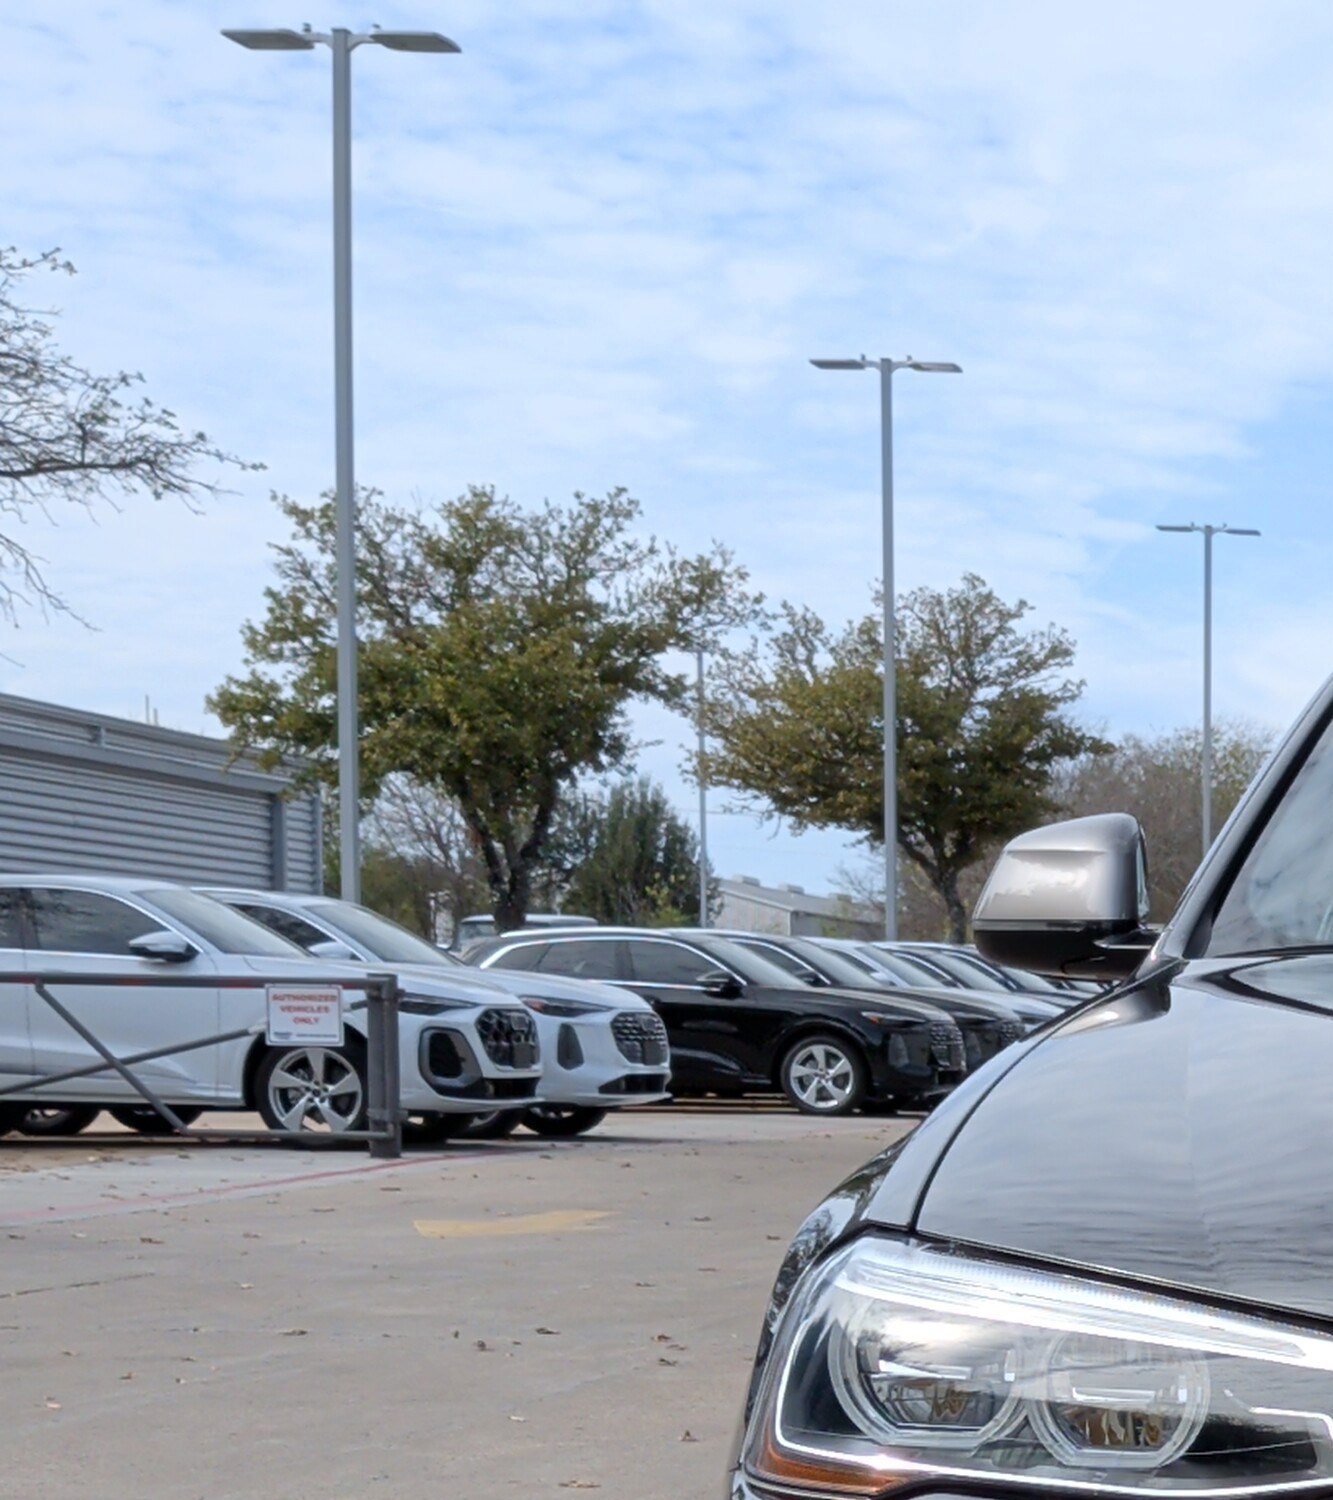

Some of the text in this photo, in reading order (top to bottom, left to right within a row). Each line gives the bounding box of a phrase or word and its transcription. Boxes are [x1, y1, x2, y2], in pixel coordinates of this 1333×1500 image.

[272, 993, 338, 1002] AUTHORIZED
[280, 1005, 329, 1013] VEHICLES
[292, 1016, 319, 1025] ONLY
